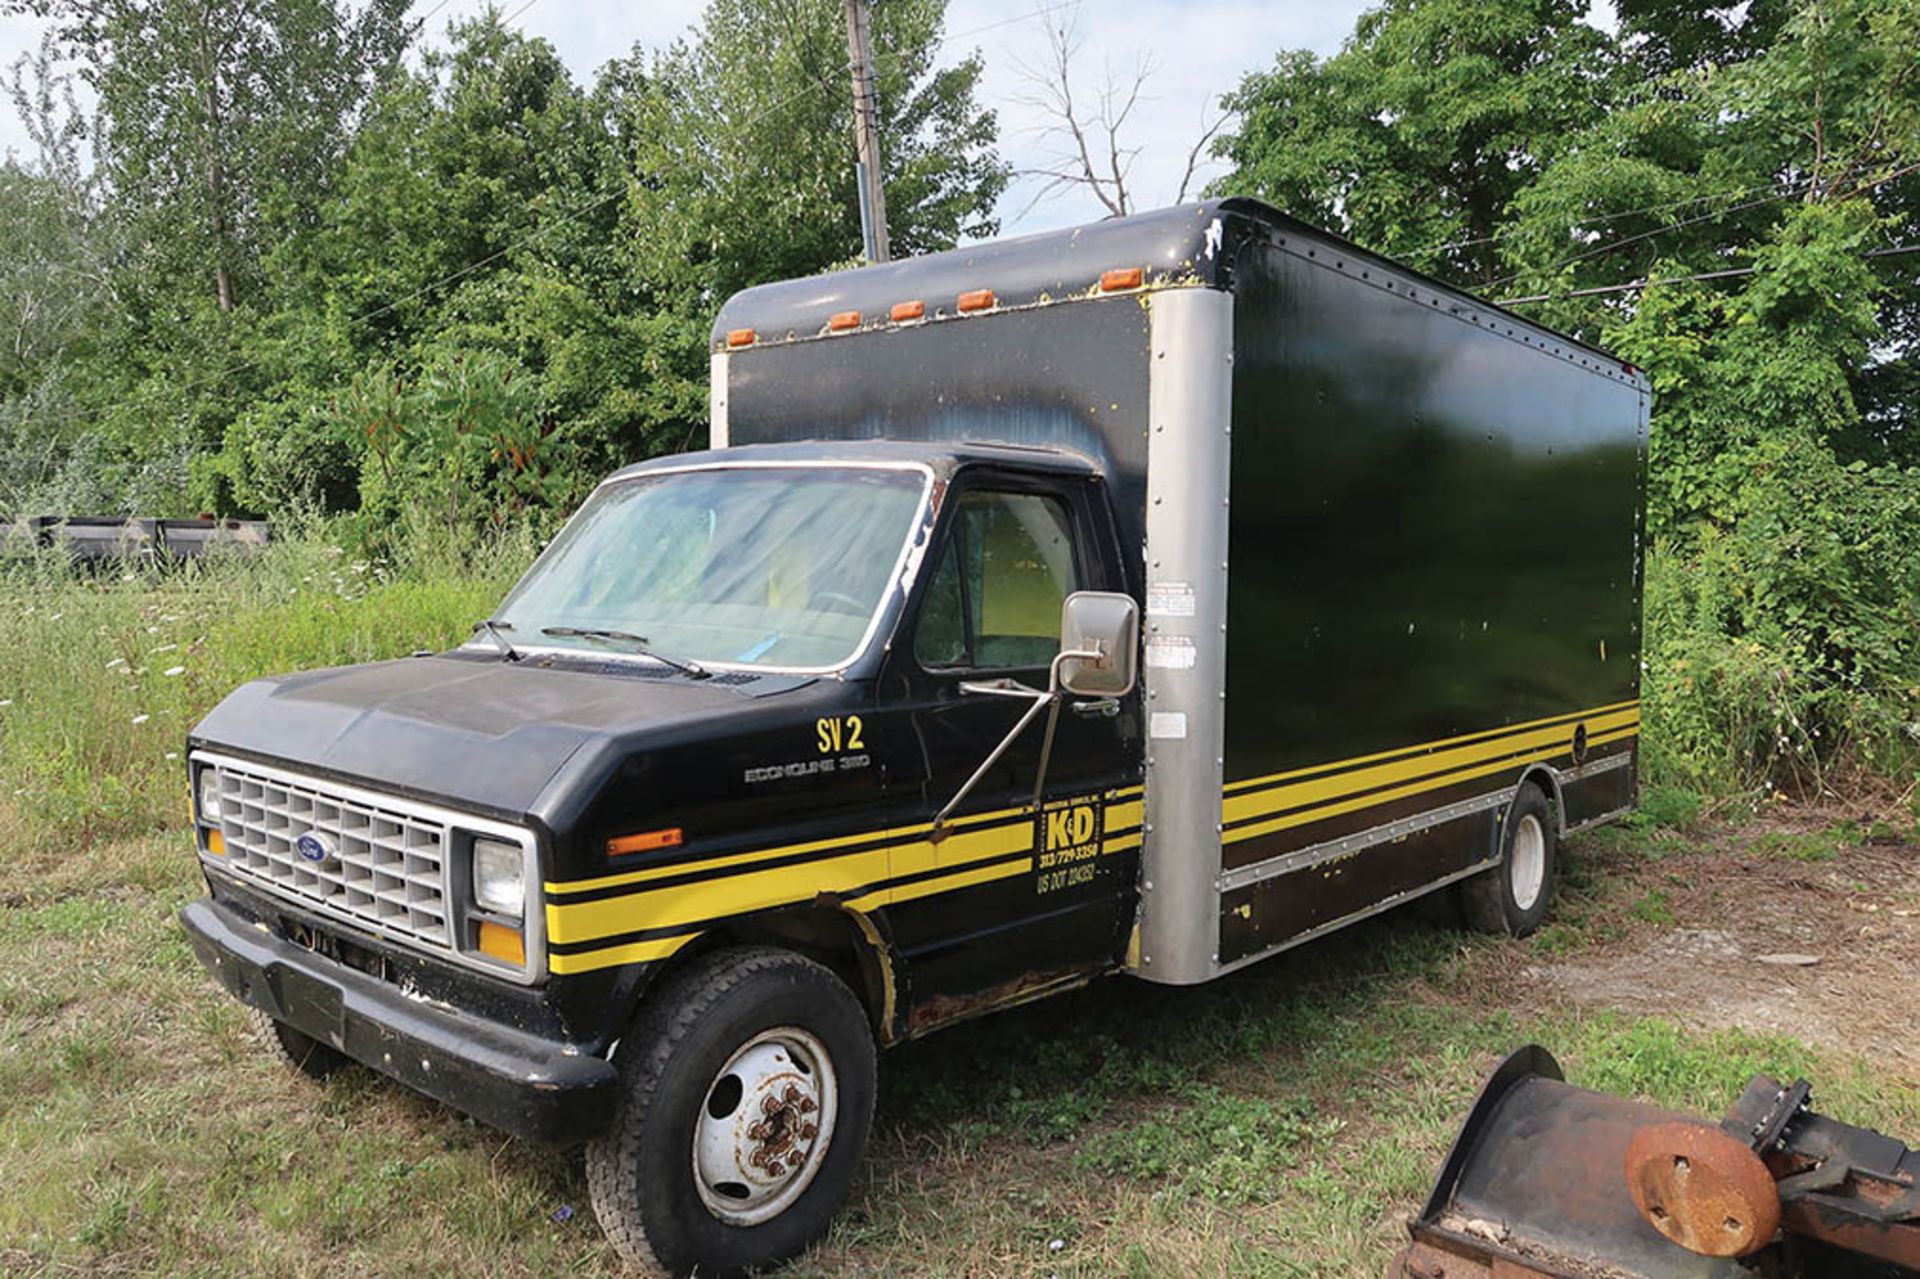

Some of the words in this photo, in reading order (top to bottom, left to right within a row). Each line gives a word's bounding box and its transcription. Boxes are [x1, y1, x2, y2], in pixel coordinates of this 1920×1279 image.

[817, 717, 841, 753] SV
[846, 715, 865, 749] 2
[744, 759, 835, 783] ECONOLINE
[1046, 806, 1095, 850] K&D
[1050, 869, 1068, 891] DOT
